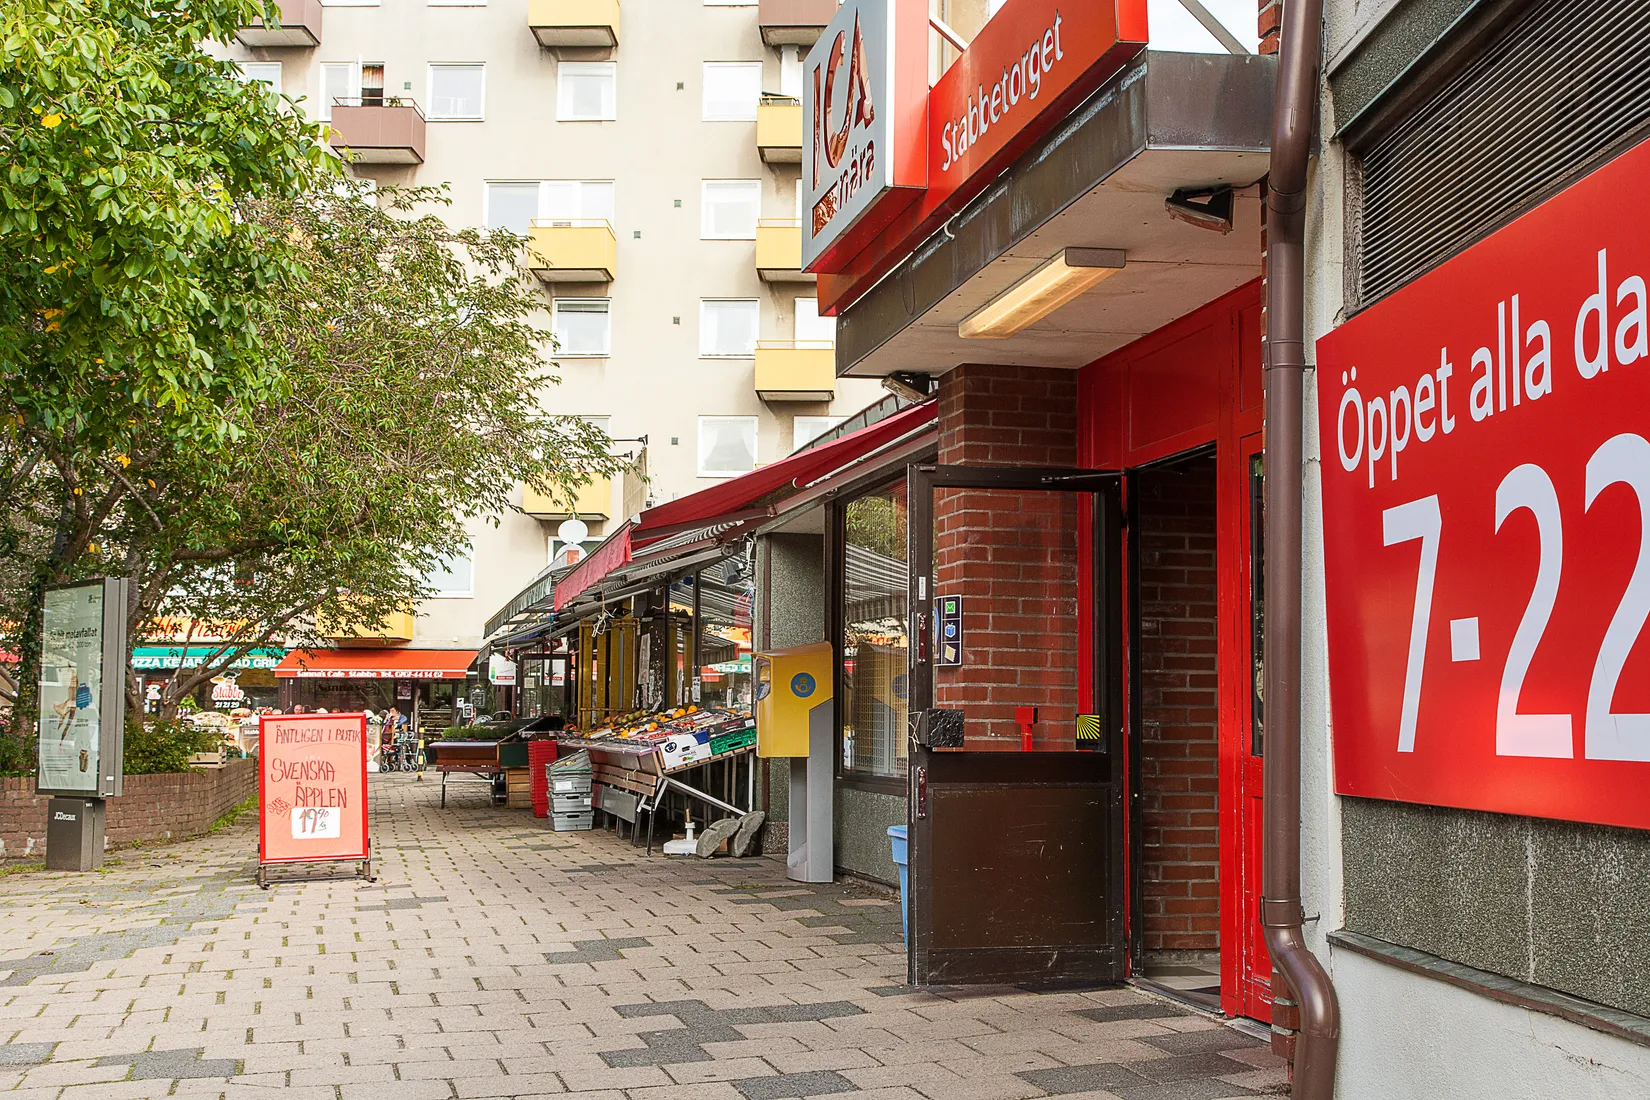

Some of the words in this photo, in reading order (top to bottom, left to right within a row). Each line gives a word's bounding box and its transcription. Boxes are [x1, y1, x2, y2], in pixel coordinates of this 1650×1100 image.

[813, 8, 875, 191] ICA
[941, 8, 1064, 172] Stabbetorget
[838, 139, 875, 210] nära
[1337, 346, 1456, 489] Öppet
[1469, 293, 1553, 423] alla
[213, 685, 242, 699] Stabbe
[276, 725, 324, 744] ÄNTLIGEN
[271, 758, 336, 782] SVENSKA
[295, 781, 347, 808] ÄPPLEN
[54, 811, 76, 821] JCDecaux
